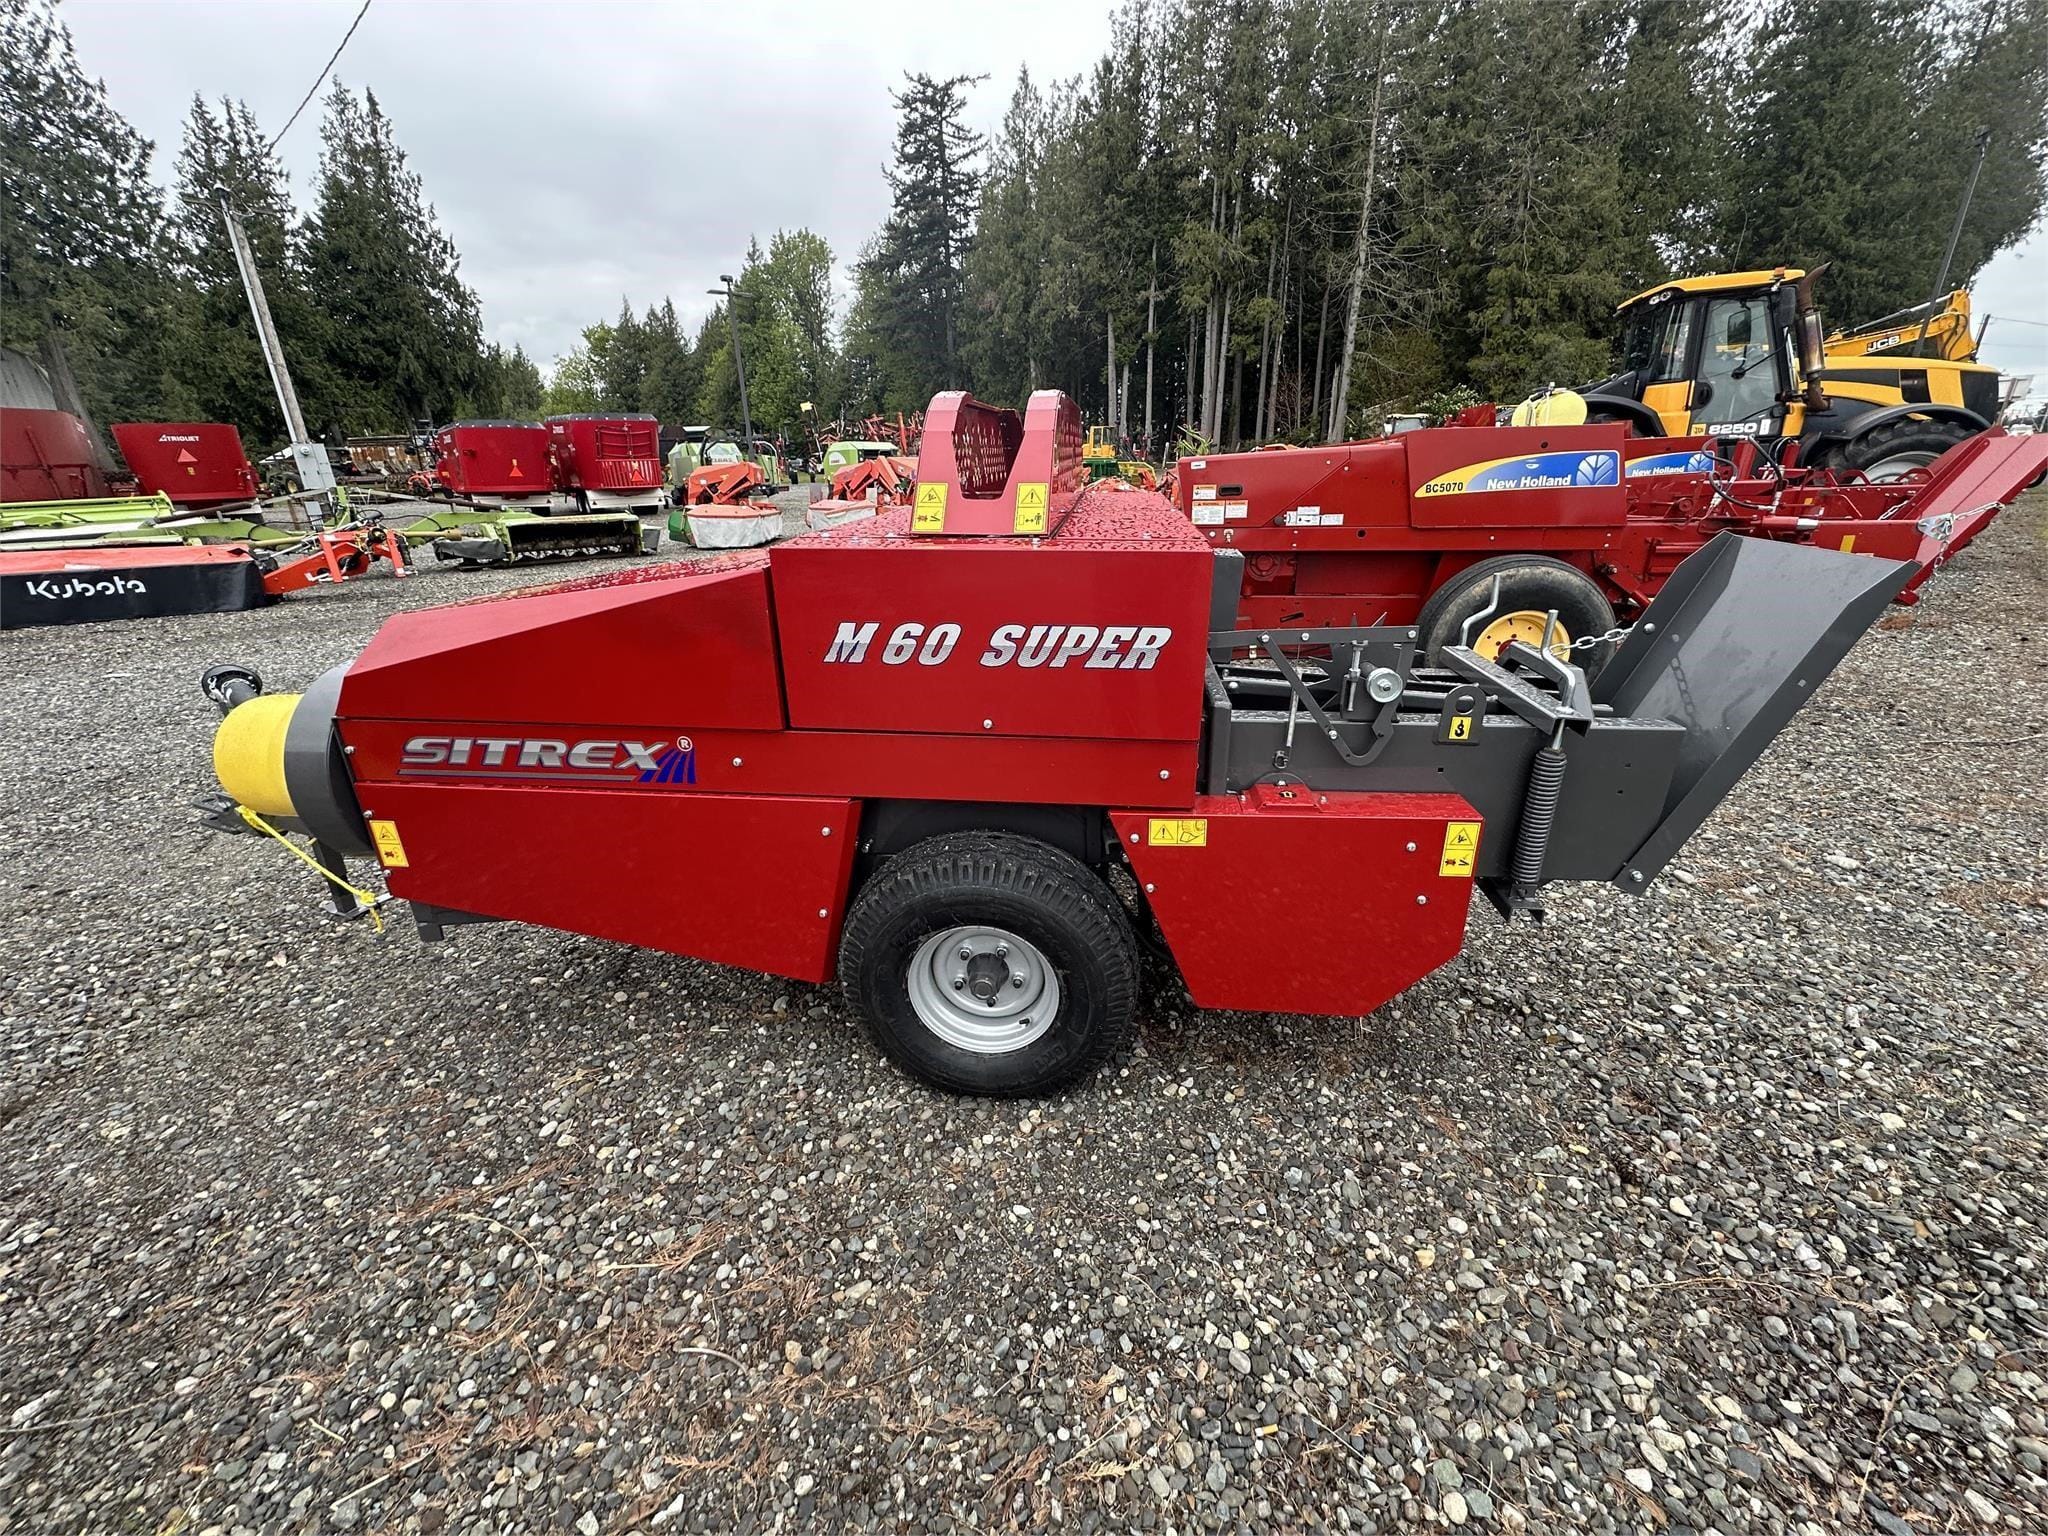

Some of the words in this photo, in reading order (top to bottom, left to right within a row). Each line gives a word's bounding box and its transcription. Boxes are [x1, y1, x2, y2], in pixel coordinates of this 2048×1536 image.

[1867, 335, 1900, 351] JCB
[1708, 422, 1758, 435] 8250
[1631, 469, 1651, 477] New
[1652, 465, 1685, 475] Holland
[1425, 481, 1464, 494] BC5070
[1486, 478, 1516, 490] New
[1519, 474, 1572, 488] Holland
[26, 575, 147, 599] Kubota
[823, 621, 881, 664] M
[881, 621, 963, 666] 60
[979, 623, 1174, 670] SUPER
[401, 736, 669, 770] SITREX
